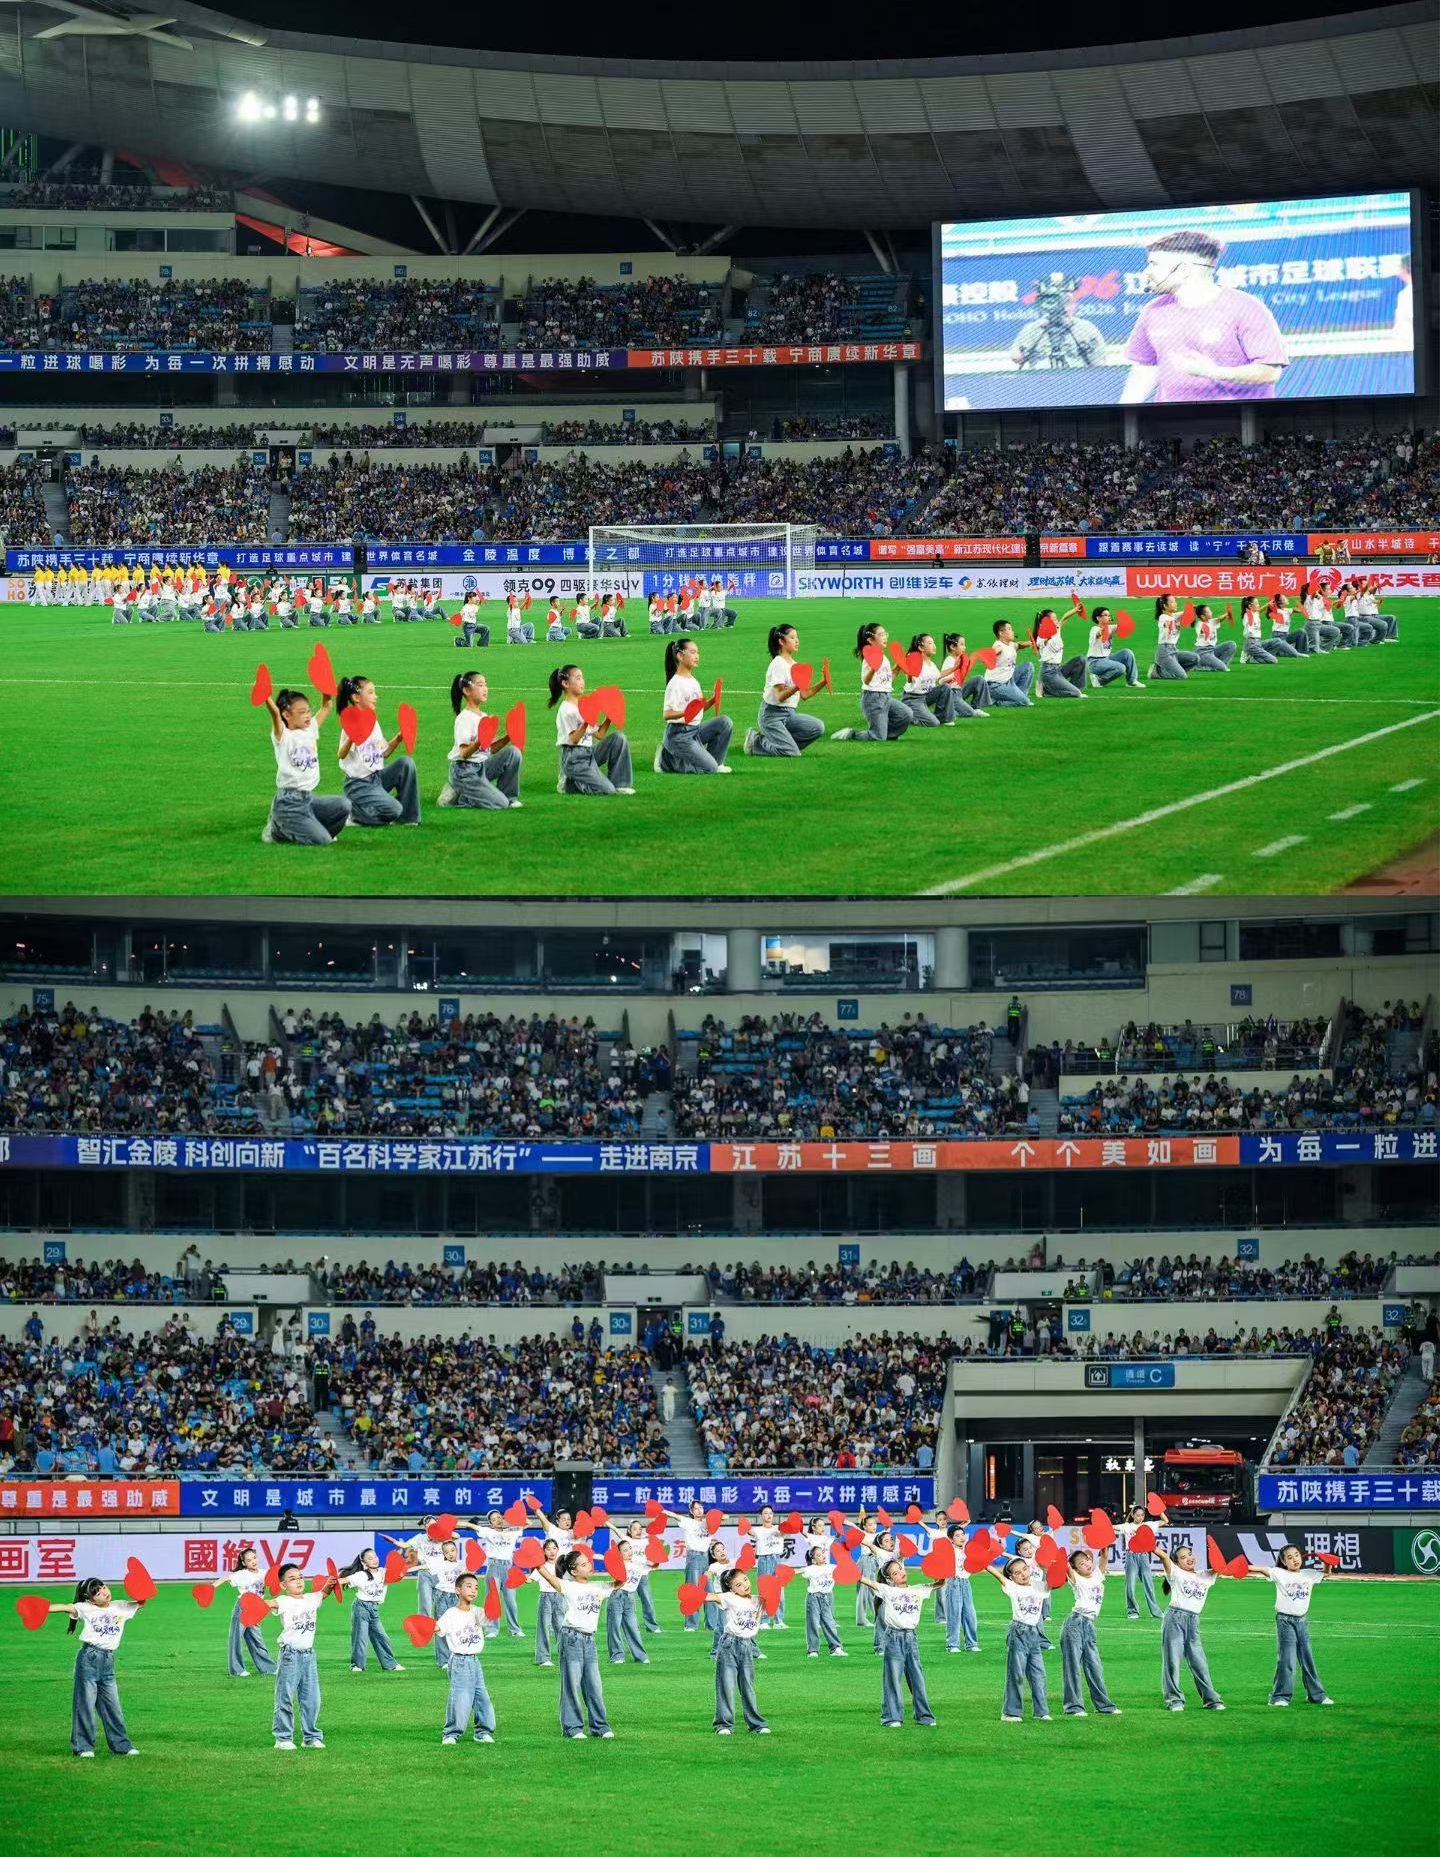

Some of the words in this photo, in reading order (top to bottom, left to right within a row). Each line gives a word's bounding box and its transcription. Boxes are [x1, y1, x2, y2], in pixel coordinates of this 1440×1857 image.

[0, 354, 127, 371] 一粒进球喝彩
[145, 354, 316, 371] 为每一次拼搏感动
[343, 353, 472, 371] 文明是无声喝彩
[482, 351, 611, 369] 尊重是最强助威
[650, 348, 778, 367] 苏陕携手三十载
[788, 344, 918, 364] 宁商赓续新华章
[664, 546, 761, 558] 打造足球重点城市
[767, 545, 864, 558] 建设世界体育名城
[1098, 541, 1179, 553] 跟着赛事去读城
[1328, 537, 1416, 550] 一山水半城诗
[17, 552, 115, 567] 苏陕携手三十载
[124, 551, 220, 566] 宁商赓续新华章
[236, 551, 334, 564] 打造足球重点城市
[341, 550, 438, 563] 建世界体育名城
[462, 548, 541, 562] 金陵温度
[562, 547, 640, 561] 博爱之都
[502, 577, 556, 593] 领克09
[798, 576, 884, 590] SKYWORTH
[889, 575, 954, 590] 创维汽车
[1217, 571, 1298, 591] 吾悦广场
[76, 1138, 178, 1166] 智汇金陵
[184, 1141, 285, 1168] 科创向新
[732, 1143, 937, 1171] 江苏十三画
[1010, 1139, 1218, 1168] 个个美如画
[1258, 1131, 1439, 1163] 为每一粒进
[1149, 1368, 1162, 1383] C
[1, 1488, 169, 1509] 尊重是最强助威
[201, 1487, 535, 1507] 文明是城市最闪亮的名片
[592, 1486, 739, 1505] 每一粒进球喝彩
[752, 1484, 921, 1504] 为每一次拼搏感动
[1277, 1479, 1440, 1503] 苏陕携手三十载
[0, 1538, 77, 1579] 画室
[1303, 1532, 1362, 1570] 理想
